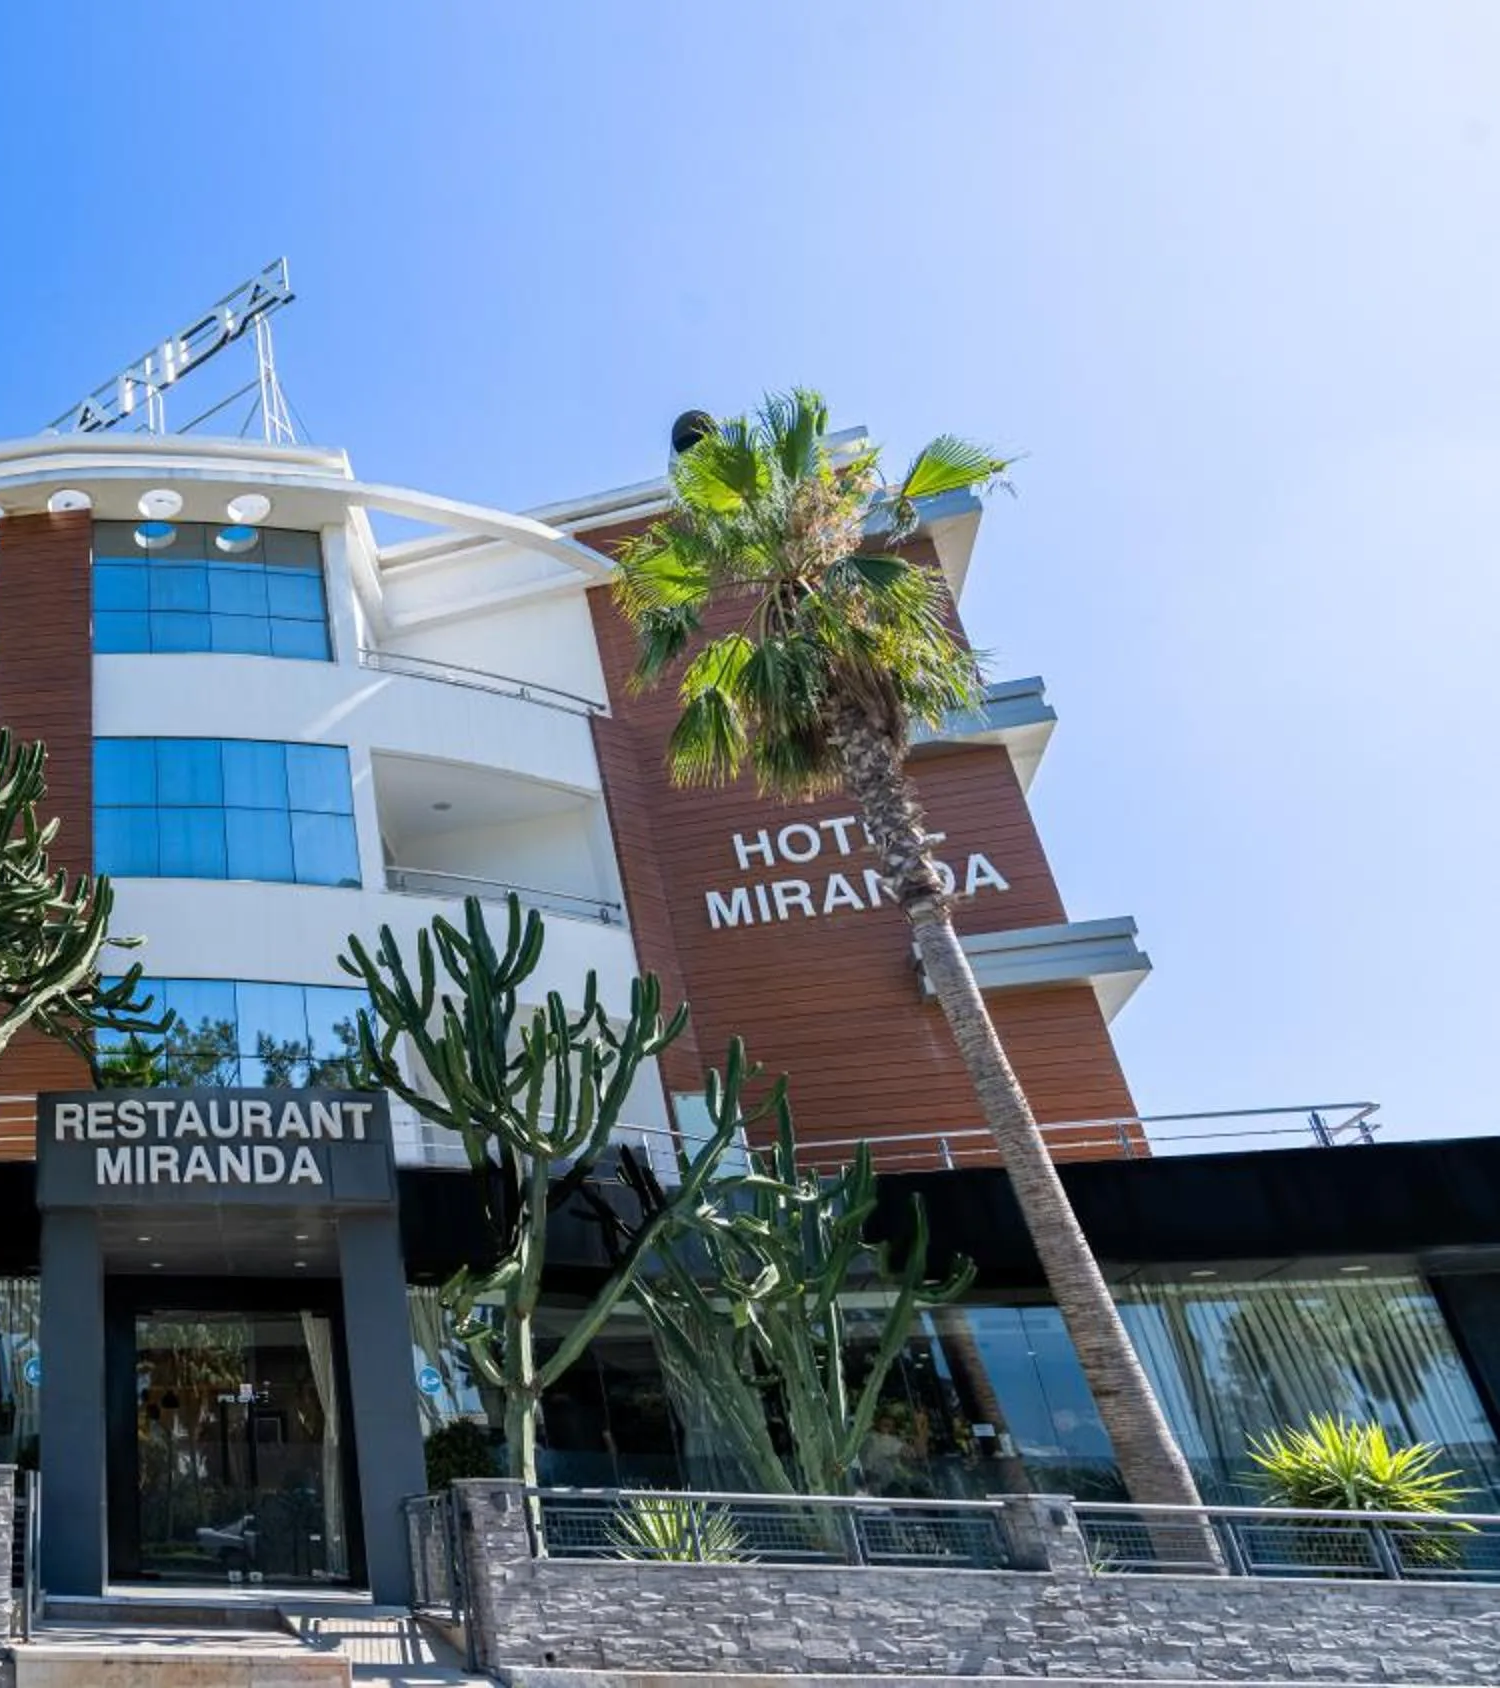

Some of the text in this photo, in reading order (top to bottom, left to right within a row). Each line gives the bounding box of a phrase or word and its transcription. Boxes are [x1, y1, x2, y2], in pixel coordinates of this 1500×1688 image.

[50, 270, 296, 434] ANDA
[732, 815, 947, 871] HOT
[54, 1099, 373, 1141] RESTAURANT
[96, 1145, 324, 1185] MIRANDA
